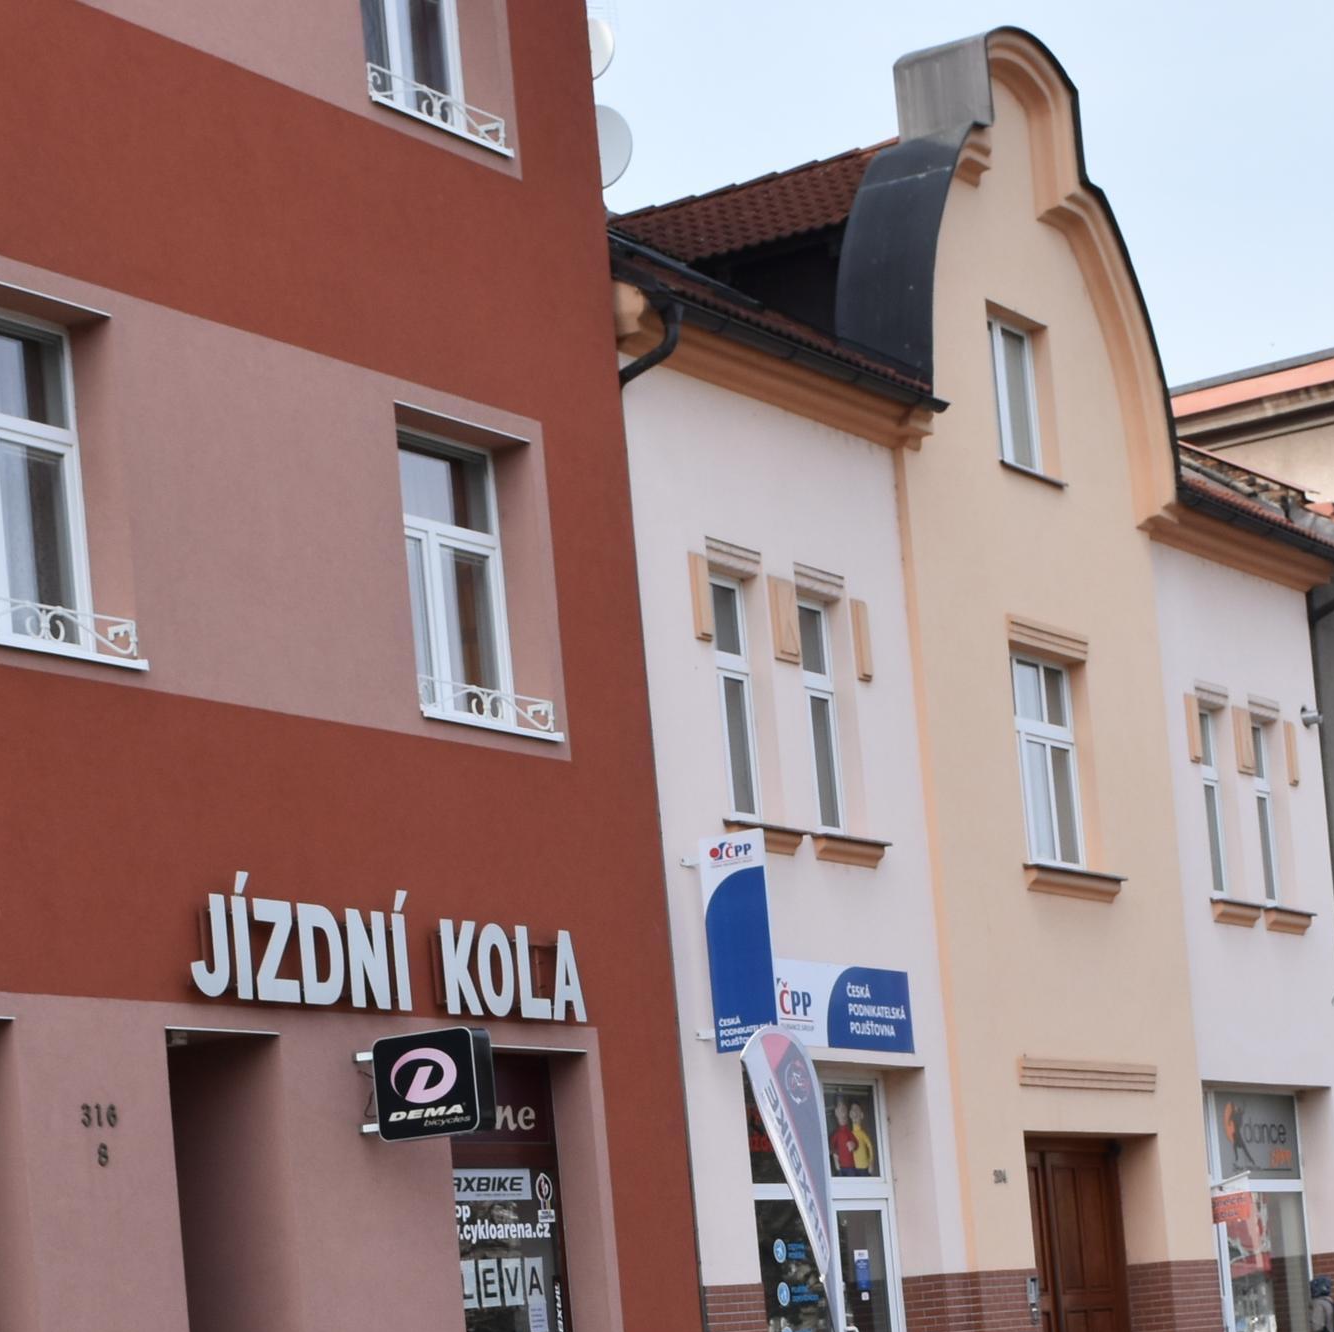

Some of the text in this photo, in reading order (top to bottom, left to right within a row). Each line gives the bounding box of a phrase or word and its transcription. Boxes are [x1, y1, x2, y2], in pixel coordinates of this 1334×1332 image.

[725, 842, 752, 858] ČPP
[190, 870, 588, 1023] JÍZDNÍ KOLA
[779, 980, 812, 1017] ČPP
[846, 982, 871, 999] ČESKÁ
[848, 1003, 906, 1020] PODNIKATELSKÁ
[718, 1015, 741, 1027] ČESKÁ
[850, 1020, 896, 1037] POJIŠŤOVNA
[81, 1103, 118, 1129] 316
[388, 1103, 465, 1122] DEMA
[424, 1114, 471, 1127] bicycles
[453, 1176, 524, 1192] AXBIKE
[461, 1265, 544, 1301] LEVA
